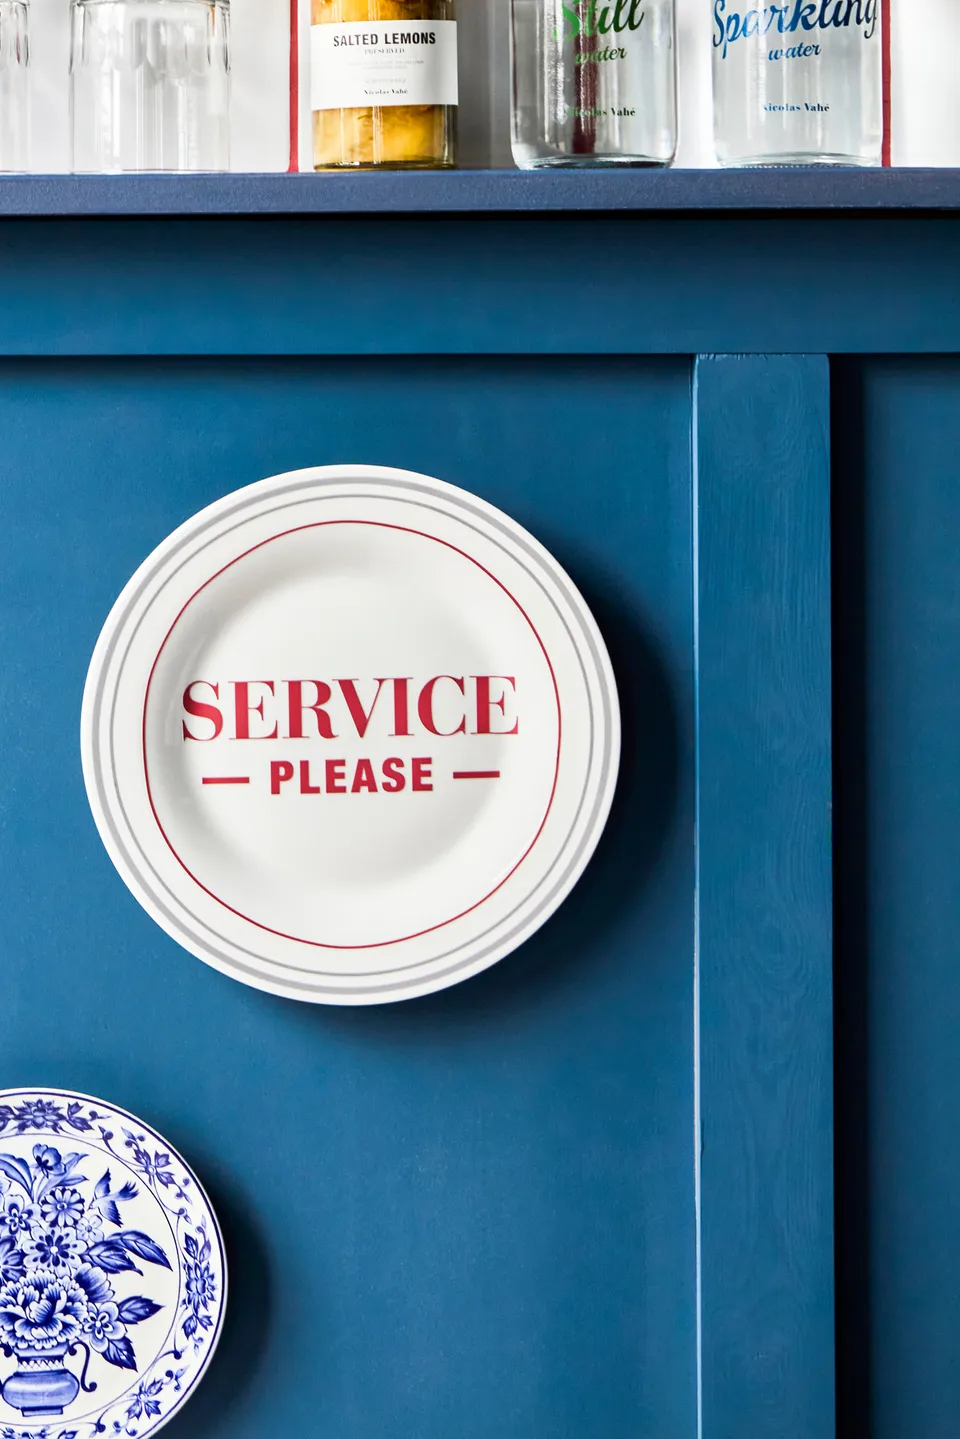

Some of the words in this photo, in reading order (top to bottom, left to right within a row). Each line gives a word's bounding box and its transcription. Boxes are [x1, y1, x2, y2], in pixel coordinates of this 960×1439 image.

[333, 33, 379, 47] SALTED
[384, 32, 436, 45] LEMONS
[575, 45, 627, 65] water
[768, 42, 822, 61] water
[611, 106, 636, 117] Vahé
[804, 102, 830, 112] Vahé
[181, 674, 519, 743] SERVICE
[270, 756, 434, 795] PLEASE
